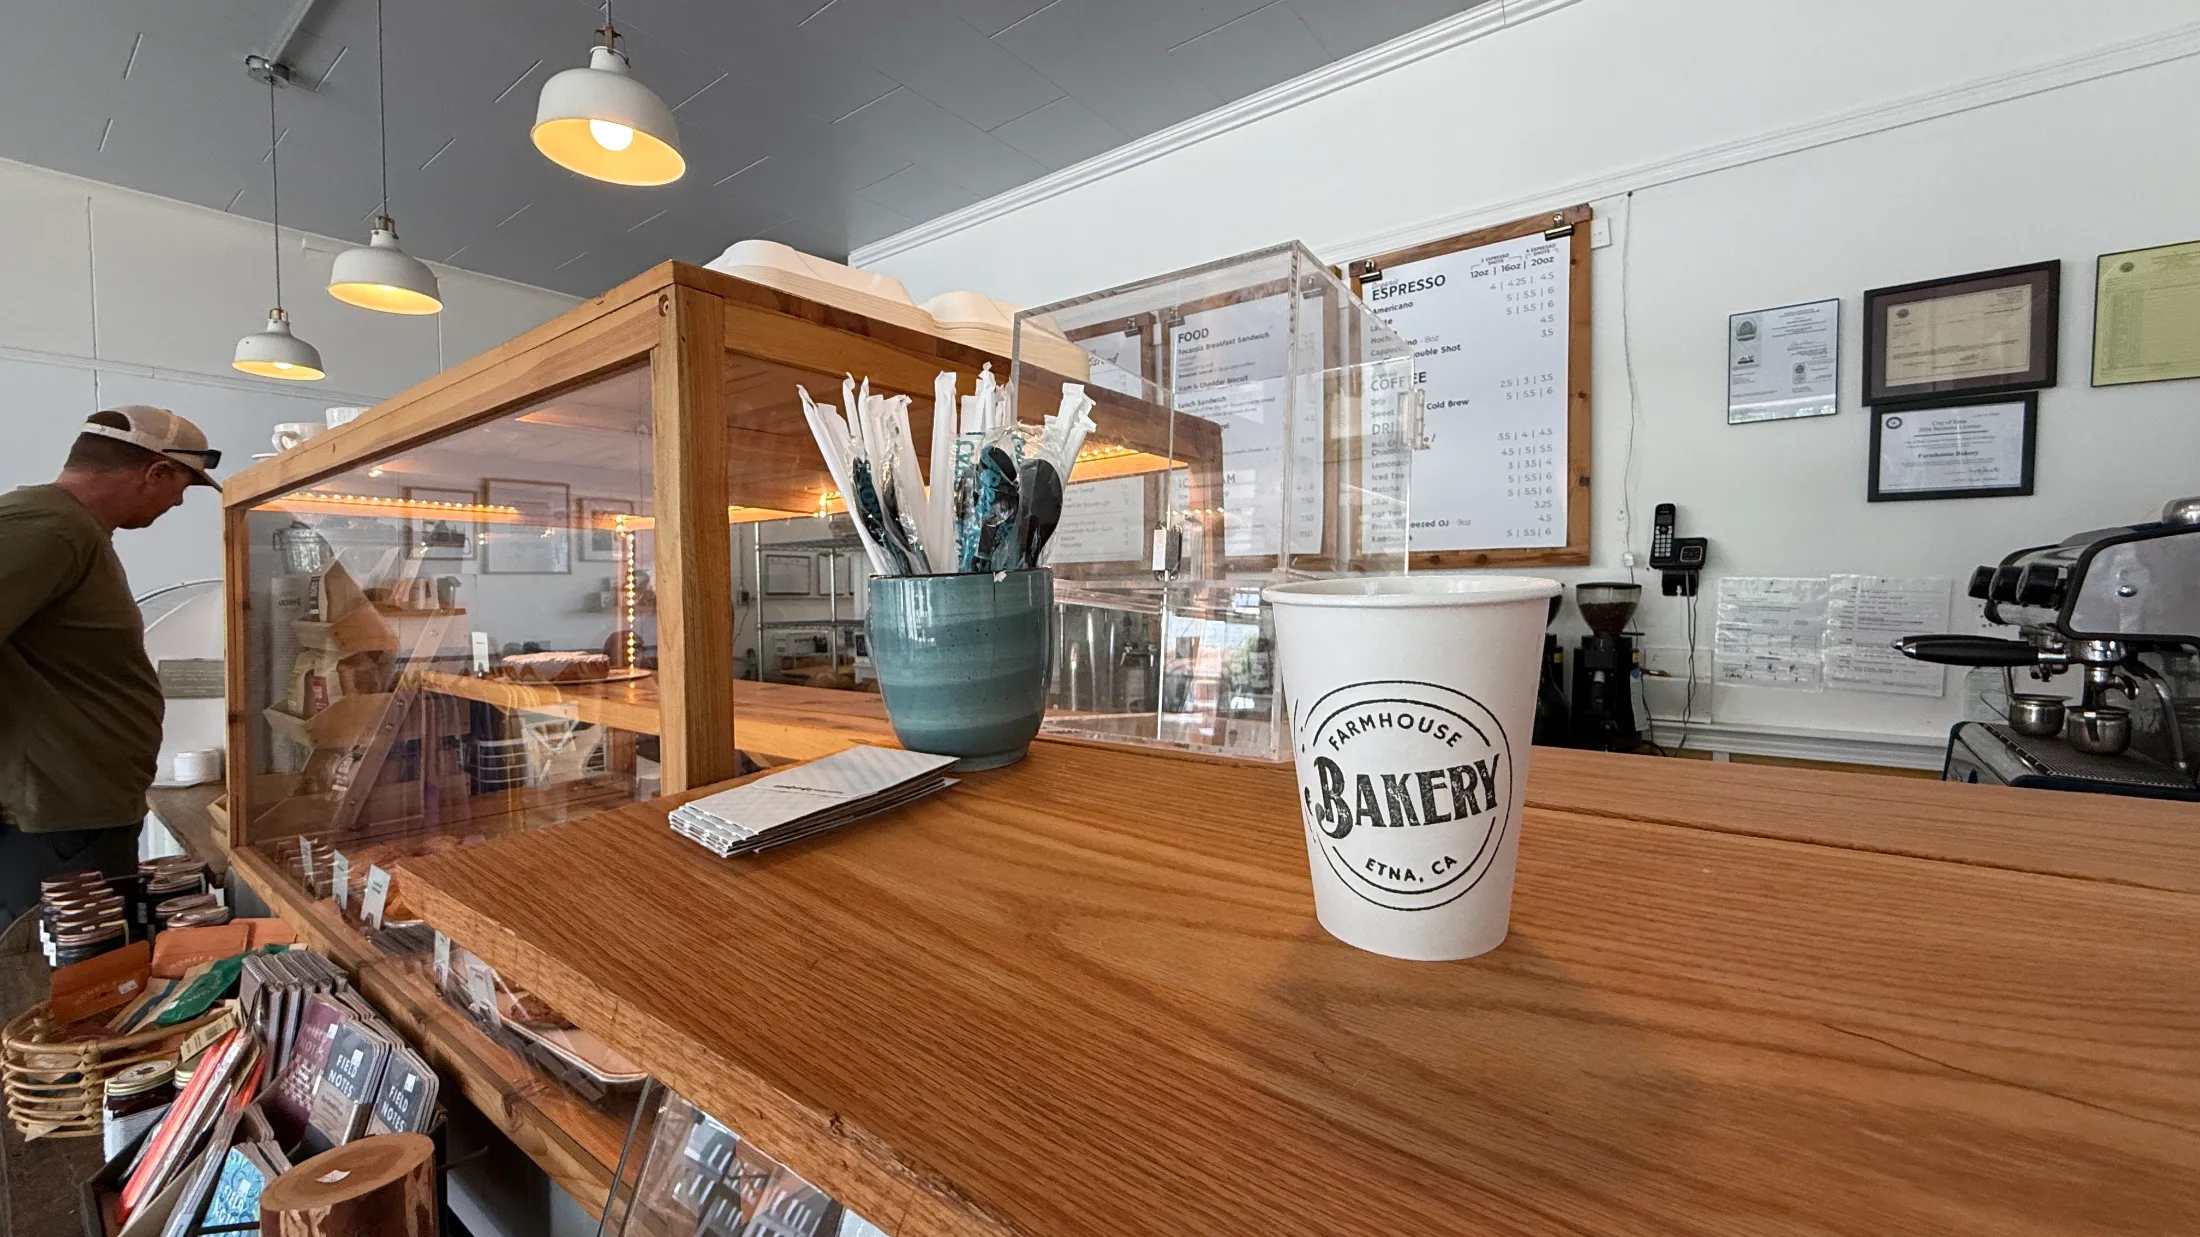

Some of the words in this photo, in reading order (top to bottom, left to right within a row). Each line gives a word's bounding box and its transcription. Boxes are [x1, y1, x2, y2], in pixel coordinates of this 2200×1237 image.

[1531, 243, 1556, 253] ESPRESSO
[1485, 253, 1510, 262] ESPRESSO
[1470, 269, 1489, 278] 12oz
[1501, 263, 1522, 272] 16oz
[1531, 256, 1554, 266] 20oz
[1372, 274, 1446, 301] ESPRESSO
[1373, 301, 1414, 314] Americano
[1507, 276, 1527, 287] 4.25
[1540, 271, 1555, 281] 4.5
[1506, 293, 1512, 302] 5
[1523, 289, 1537, 299] 5.5
[1547, 285, 1555, 295] 6
[1506, 307, 1512, 315] 5
[1523, 303, 1536, 312] 5.5
[1547, 300, 1554, 308] 6
[1540, 314, 1554, 323] 4.5
[1178, 328, 1209, 343] FOOD
[1205, 338, 1236, 349] Breakfast
[1237, 332, 1270, 343] Sandwich
[1414, 347, 1438, 358] ouble
[1440, 344, 1461, 354] Shot
[1540, 328, 1554, 338] 3.5
[1500, 379, 1513, 388] 2.5
[1523, 376, 1529, 385] 3
[1540, 373, 1554, 382] 3.5
[1426, 401, 1445, 410] Cold
[1448, 399, 1469, 408] Brew
[1506, 392, 1512, 400] 5
[1523, 389, 1536, 398] 5.5
[1547, 387, 1554, 395] 6
[1497, 432, 1510, 441] 3.5
[1540, 428, 1553, 436] 4.5
[1501, 448, 1514, 456] 4.5
[1525, 446, 1531, 454] 5
[1540, 444, 1553, 453] 5.5
[1508, 461, 1513, 470] 3
[1524, 460, 1537, 468] 3.5
[1508, 475, 1514, 483] 5
[1524, 473, 1537, 481] 5.5
[1546, 472, 1552, 480] 6
[1508, 489, 1514, 497] 5
[1524, 487, 1537, 495] 5.5
[1546, 486, 1552, 494] 6
[1534, 500, 1552, 509] 3.25
[1438, 519, 1449, 527] OJ
[1538, 514, 1552, 522] 4.5
[1506, 529, 1513, 537] 5
[1523, 528, 1536, 537] 5.5
[1545, 527, 1552, 536] 6
[1328, 712, 1462, 751] FARMHOUSE
[1314, 753, 1500, 839] BAKERY
[1365, 857, 1424, 883] ETNA,
[1431, 855, 1458, 875] CA
[336, 1054, 358, 1079] FIELD
[328, 1069, 354, 1098] NOTES
[388, 1085, 409, 1113] FIELD
[381, 1101, 405, 1132] NOTES
